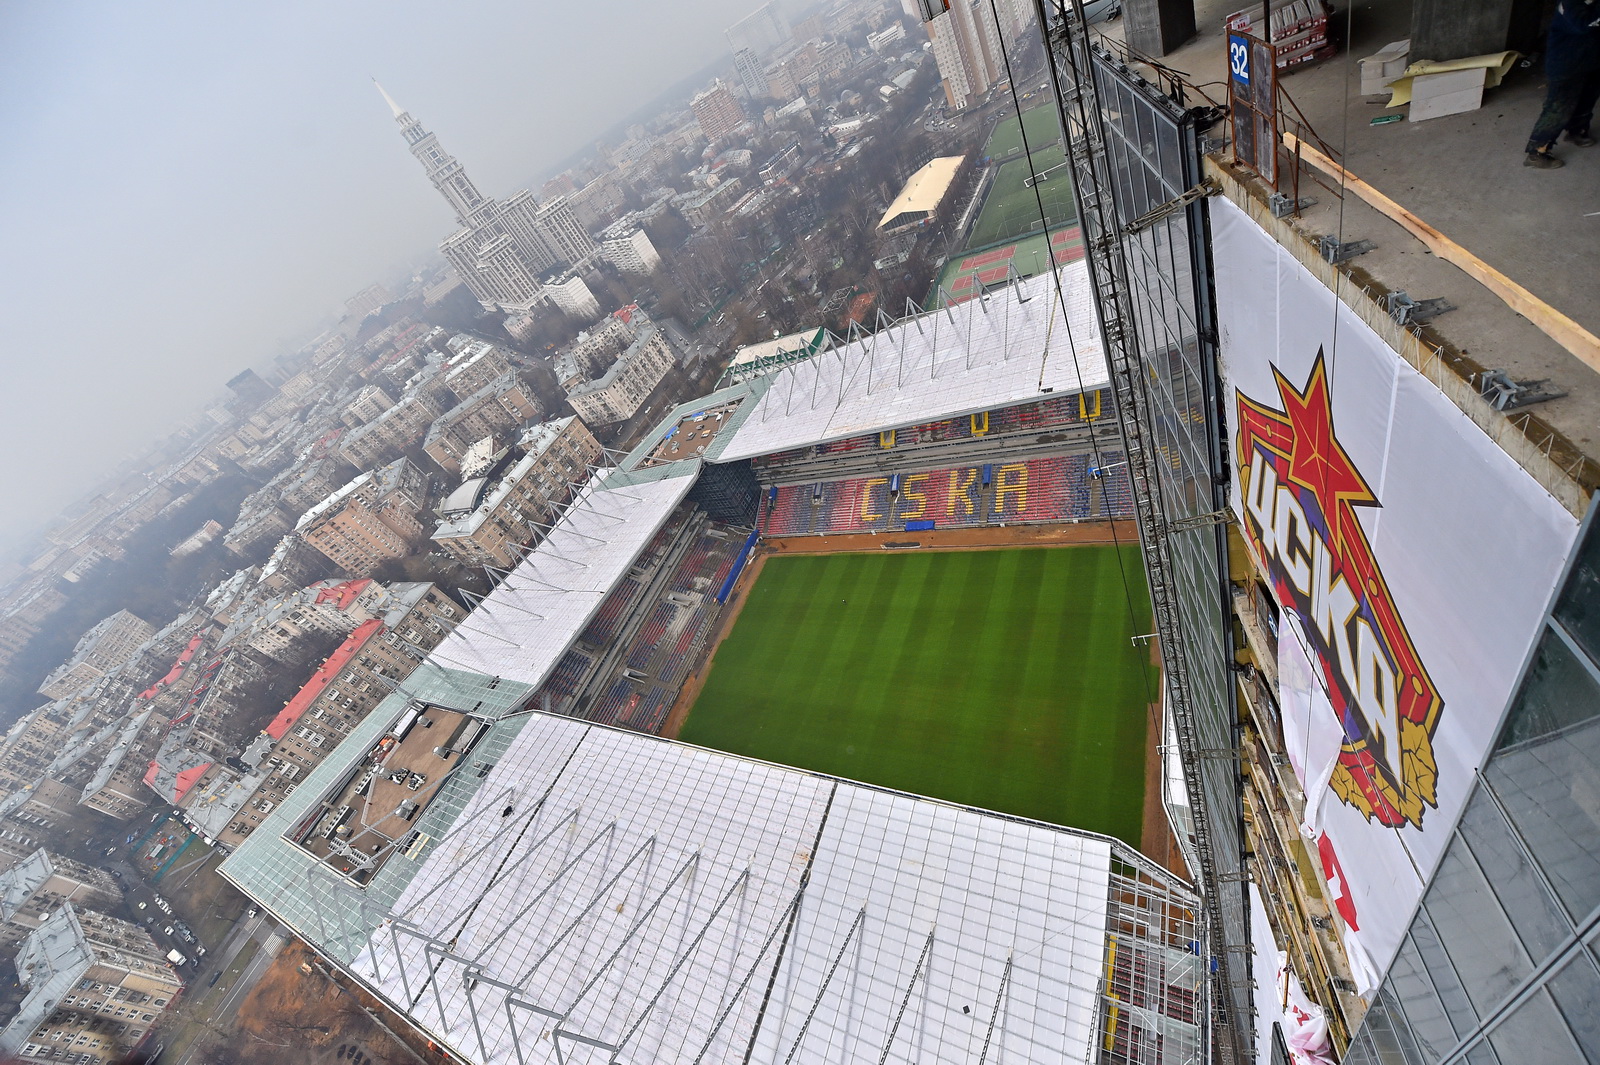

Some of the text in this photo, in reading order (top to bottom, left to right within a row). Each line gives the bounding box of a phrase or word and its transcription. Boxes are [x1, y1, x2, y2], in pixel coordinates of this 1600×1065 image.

[1230, 42, 1249, 79] 32
[861, 463, 1029, 521] CSKA
[1246, 445, 1402, 790] ЦСКА
